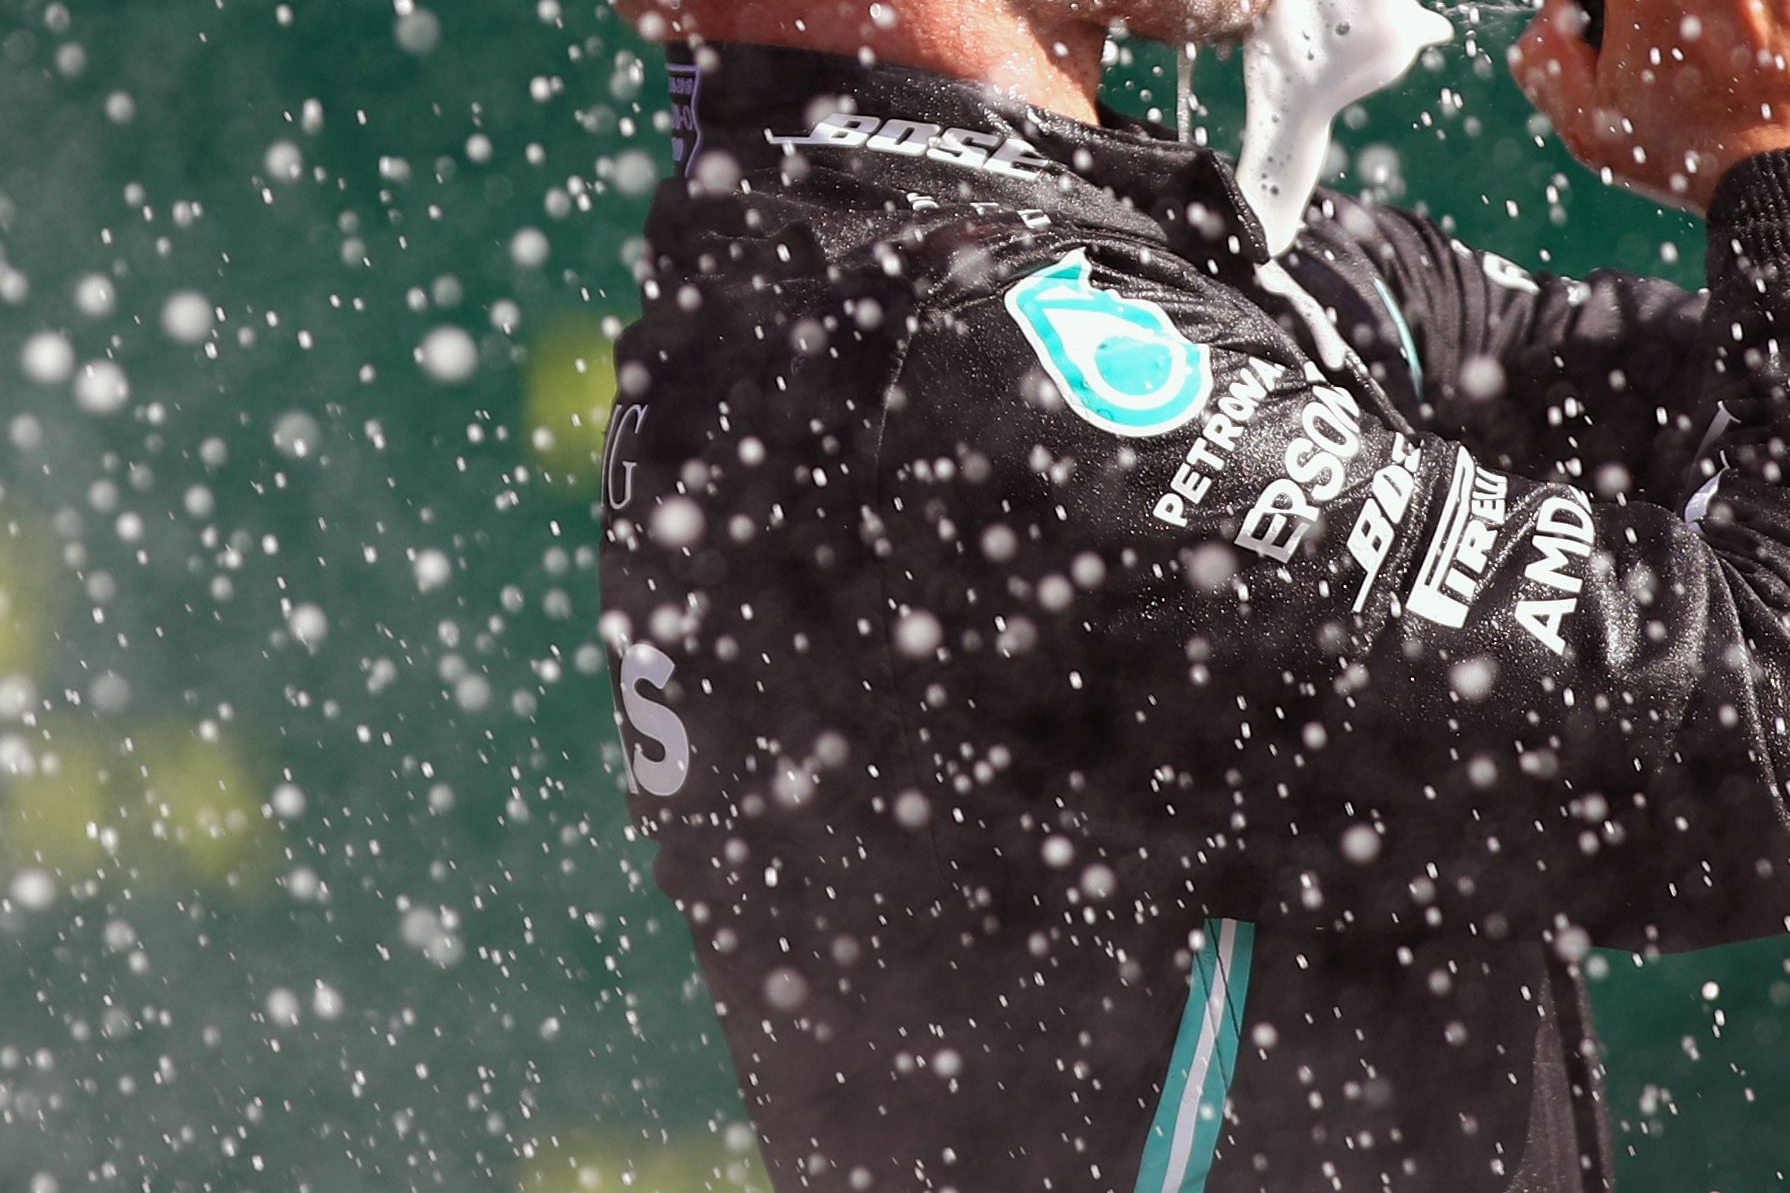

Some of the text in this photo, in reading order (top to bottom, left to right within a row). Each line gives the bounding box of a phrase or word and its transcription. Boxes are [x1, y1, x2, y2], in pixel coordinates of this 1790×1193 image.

[766, 112, 1049, 180] BOSE
[1152, 356, 1327, 528] PETRONA
[1234, 385, 1361, 564] EPSON
[1514, 496, 1596, 656] AMD
